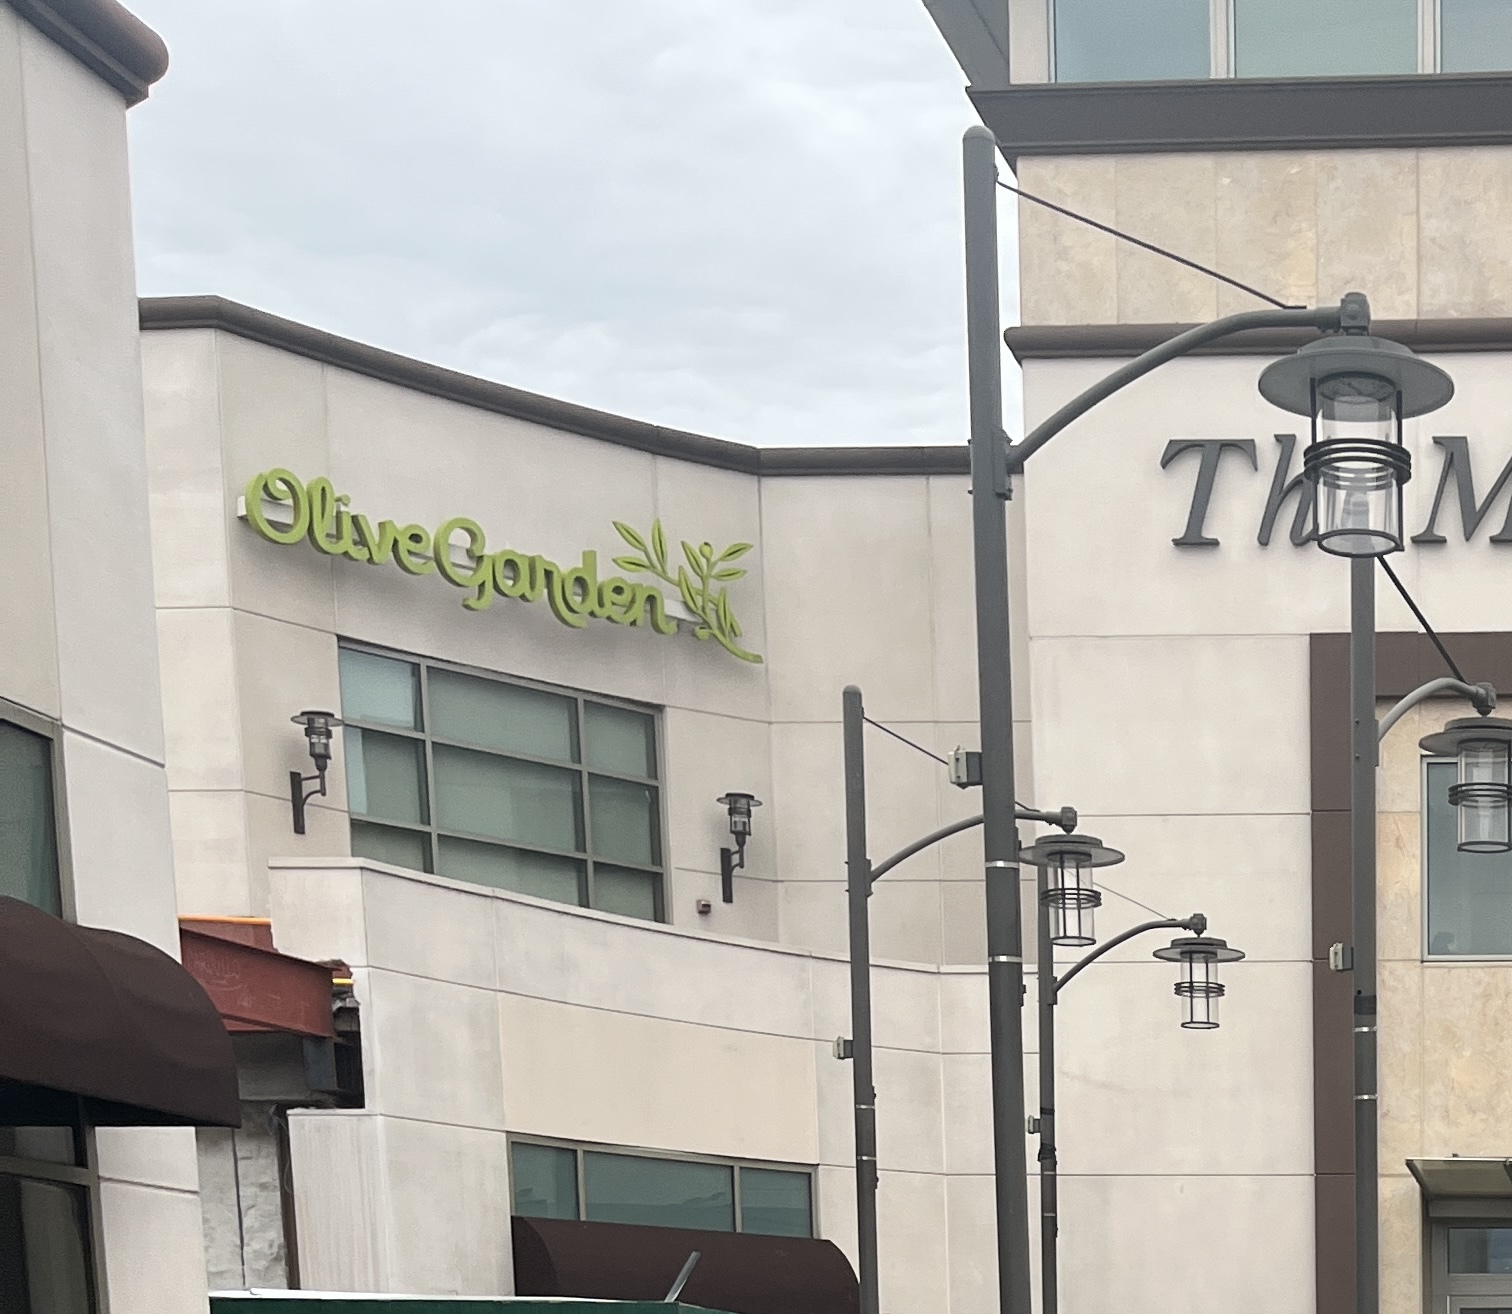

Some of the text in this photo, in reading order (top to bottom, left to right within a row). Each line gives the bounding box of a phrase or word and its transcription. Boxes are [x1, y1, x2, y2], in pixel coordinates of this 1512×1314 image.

[244, 467, 678, 635] Olive Garden
[1160, 433, 1325, 548] Th
